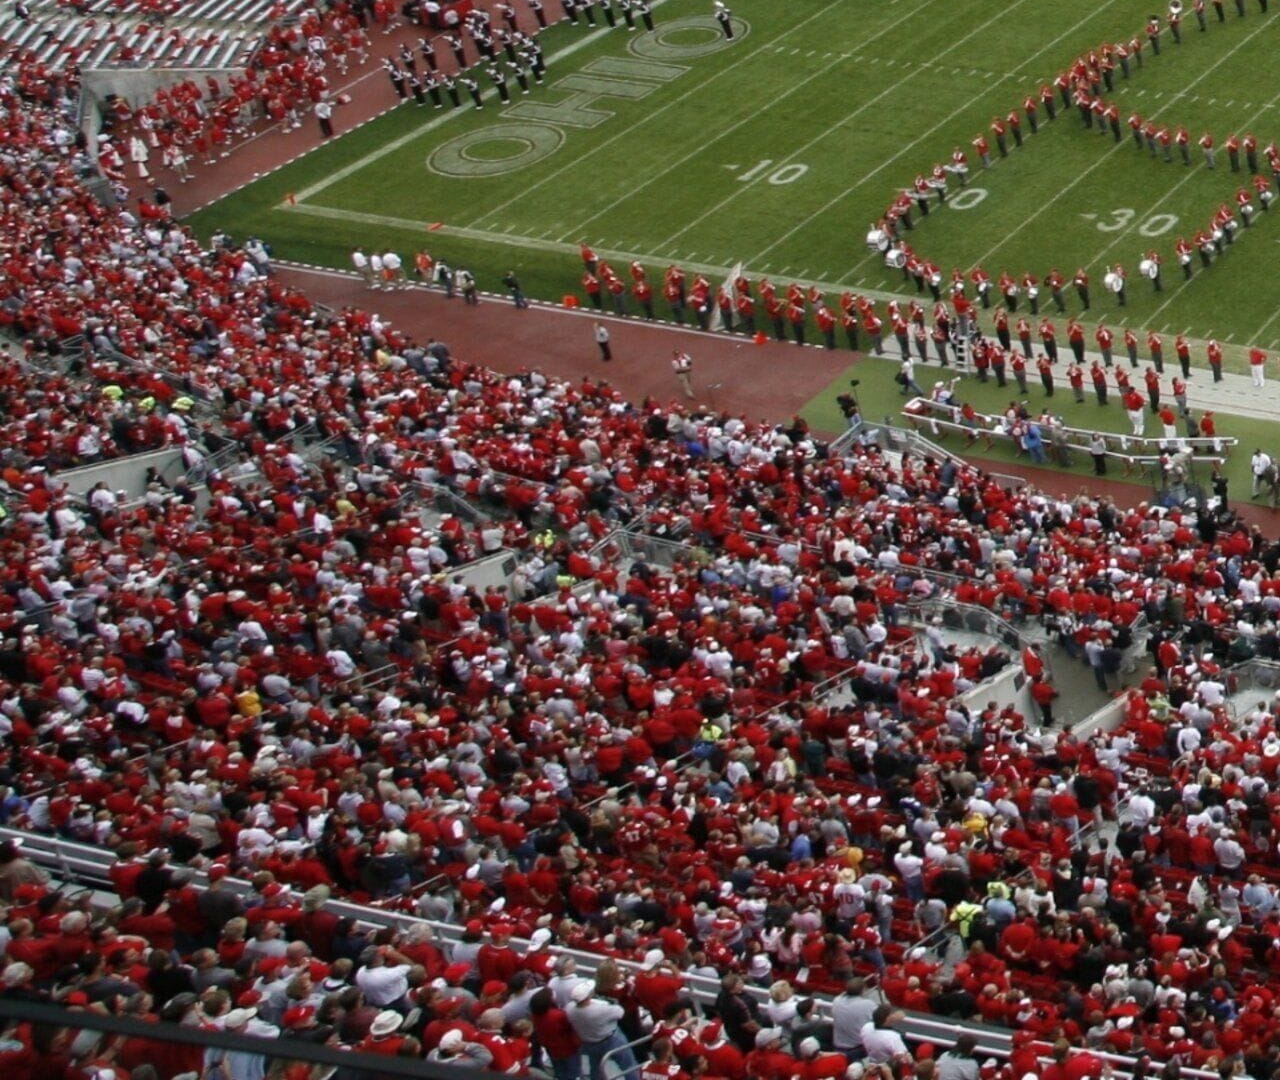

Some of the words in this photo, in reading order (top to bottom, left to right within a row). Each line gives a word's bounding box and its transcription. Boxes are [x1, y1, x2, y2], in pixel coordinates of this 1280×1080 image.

[425, 15, 751, 178] OHIO
[737, 159, 809, 185] 10
[1097, 208, 1178, 237] 30
